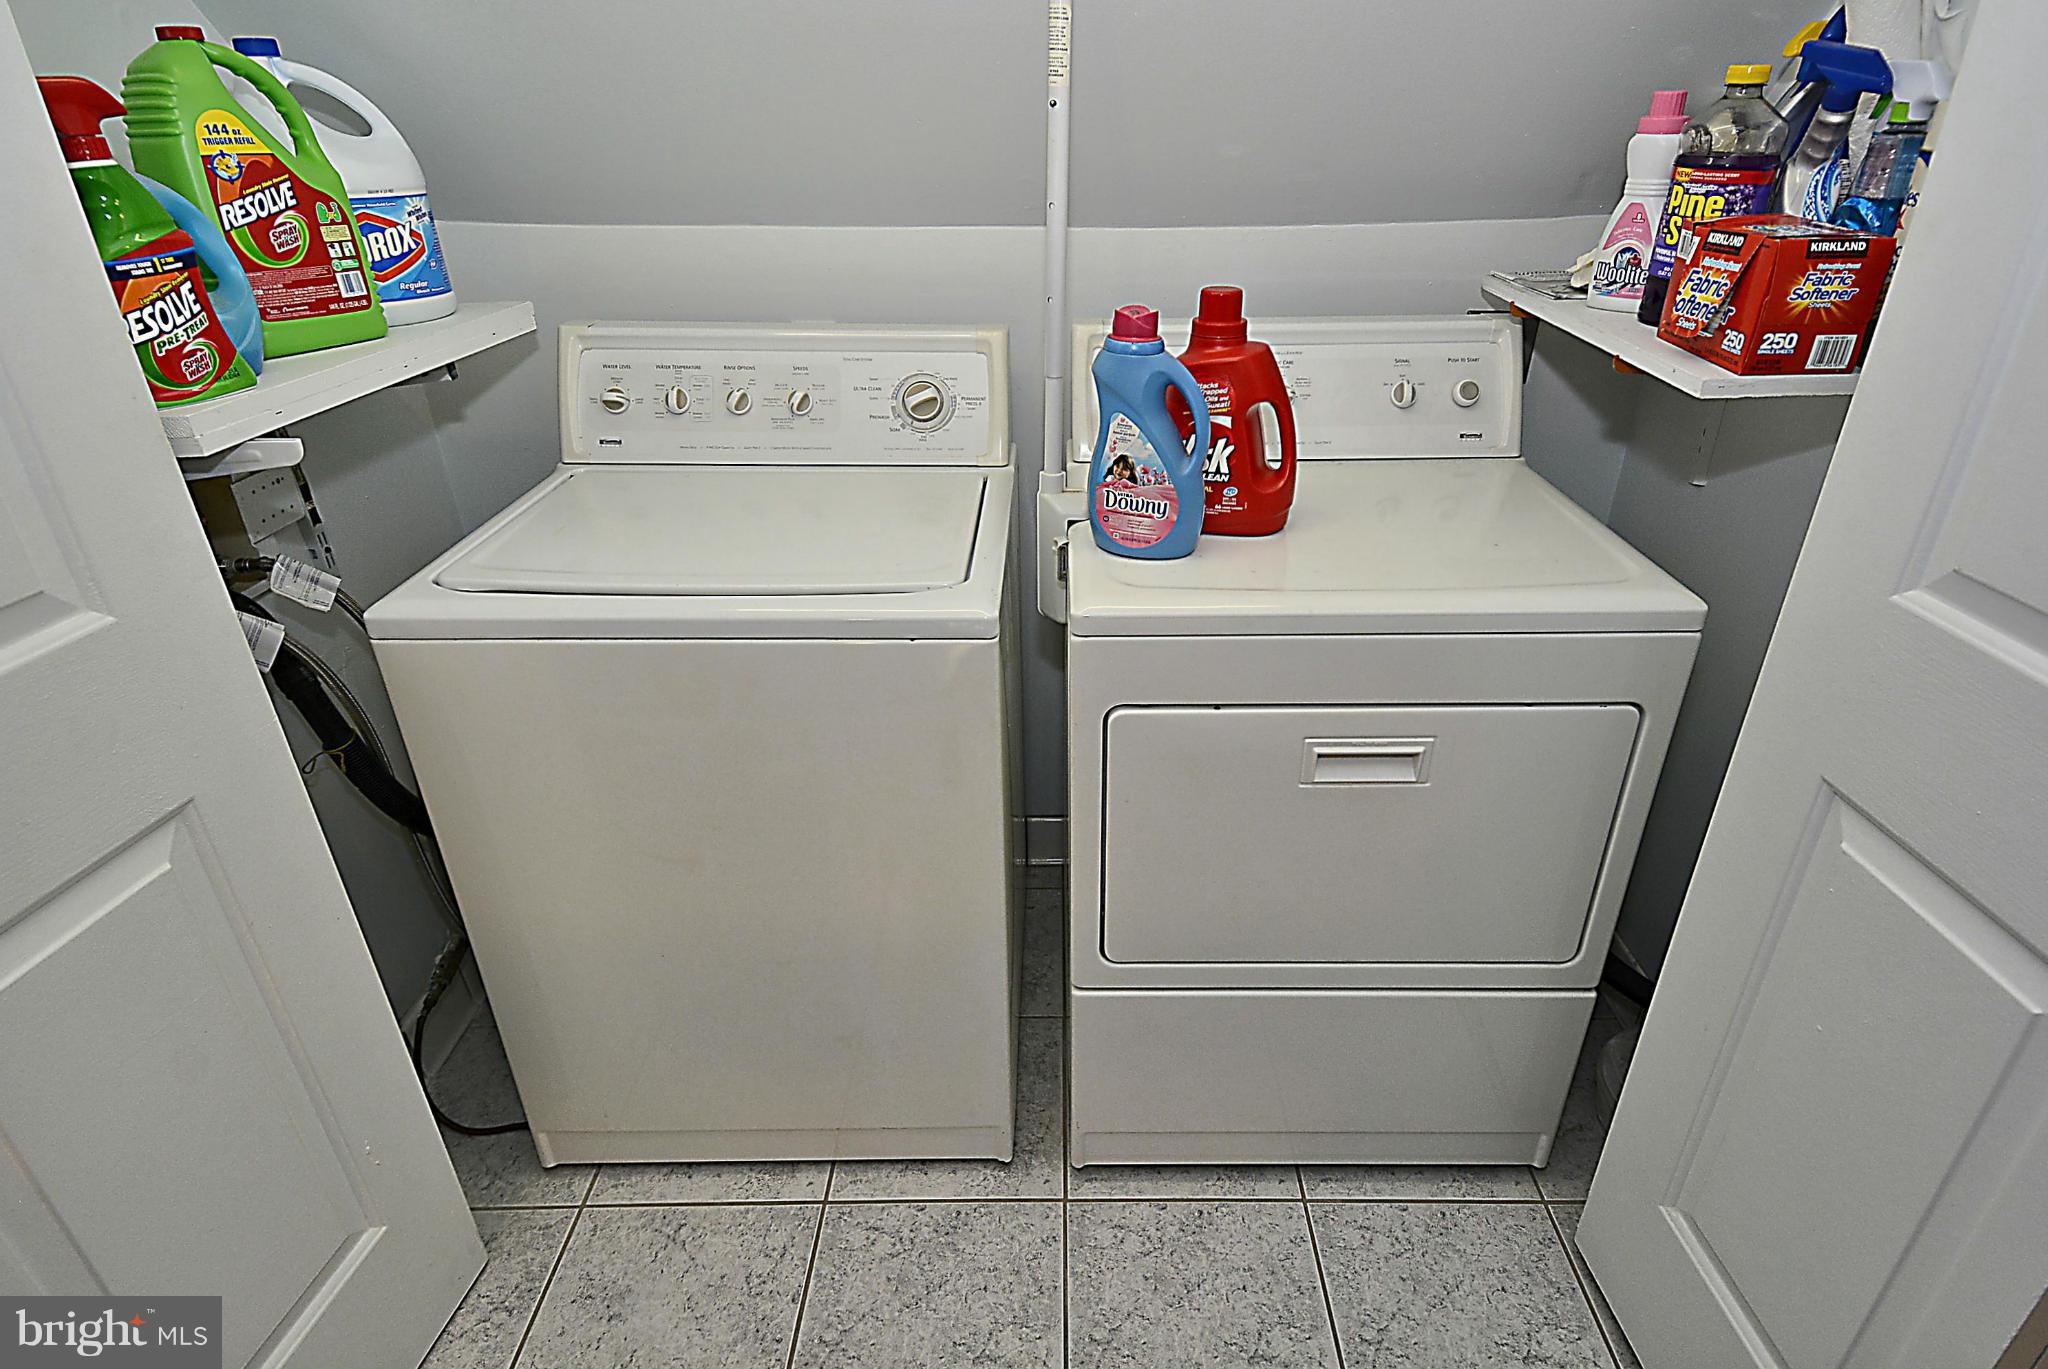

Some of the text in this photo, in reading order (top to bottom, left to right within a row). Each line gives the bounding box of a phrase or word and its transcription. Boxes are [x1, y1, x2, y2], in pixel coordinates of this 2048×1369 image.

[203, 123, 230, 136] 144
[202, 137, 256, 146] TRIGGER REFILL
[219, 180, 298, 232] RESOLVE
[1667, 184, 1726, 221] Pine
[271, 225, 298, 242] SPRAY
[361, 220, 418, 264] ROX
[1706, 231, 1745, 248] KIRKLAND
[276, 236, 300, 250] WASH
[1810, 241, 1867, 252] KIRKLAND
[1596, 262, 1649, 285] Woolite
[1801, 272, 1856, 287] Fabric
[400, 281, 428, 291] Regular
[1681, 268, 1731, 298] Fabric
[1788, 287, 1858, 302] Softener
[125, 280, 202, 344] ESOLVE
[1674, 289, 1736, 324] oftener
[156, 313, 209, 355] PRE-TREAT
[1722, 329, 1745, 350] 250
[1760, 333, 1799, 350] 250
[183, 352, 208, 372] SPRAY
[188, 362, 211, 380] WASH
[1202, 474, 1230, 482] LEAN
[1103, 489, 1169, 519] Downy
